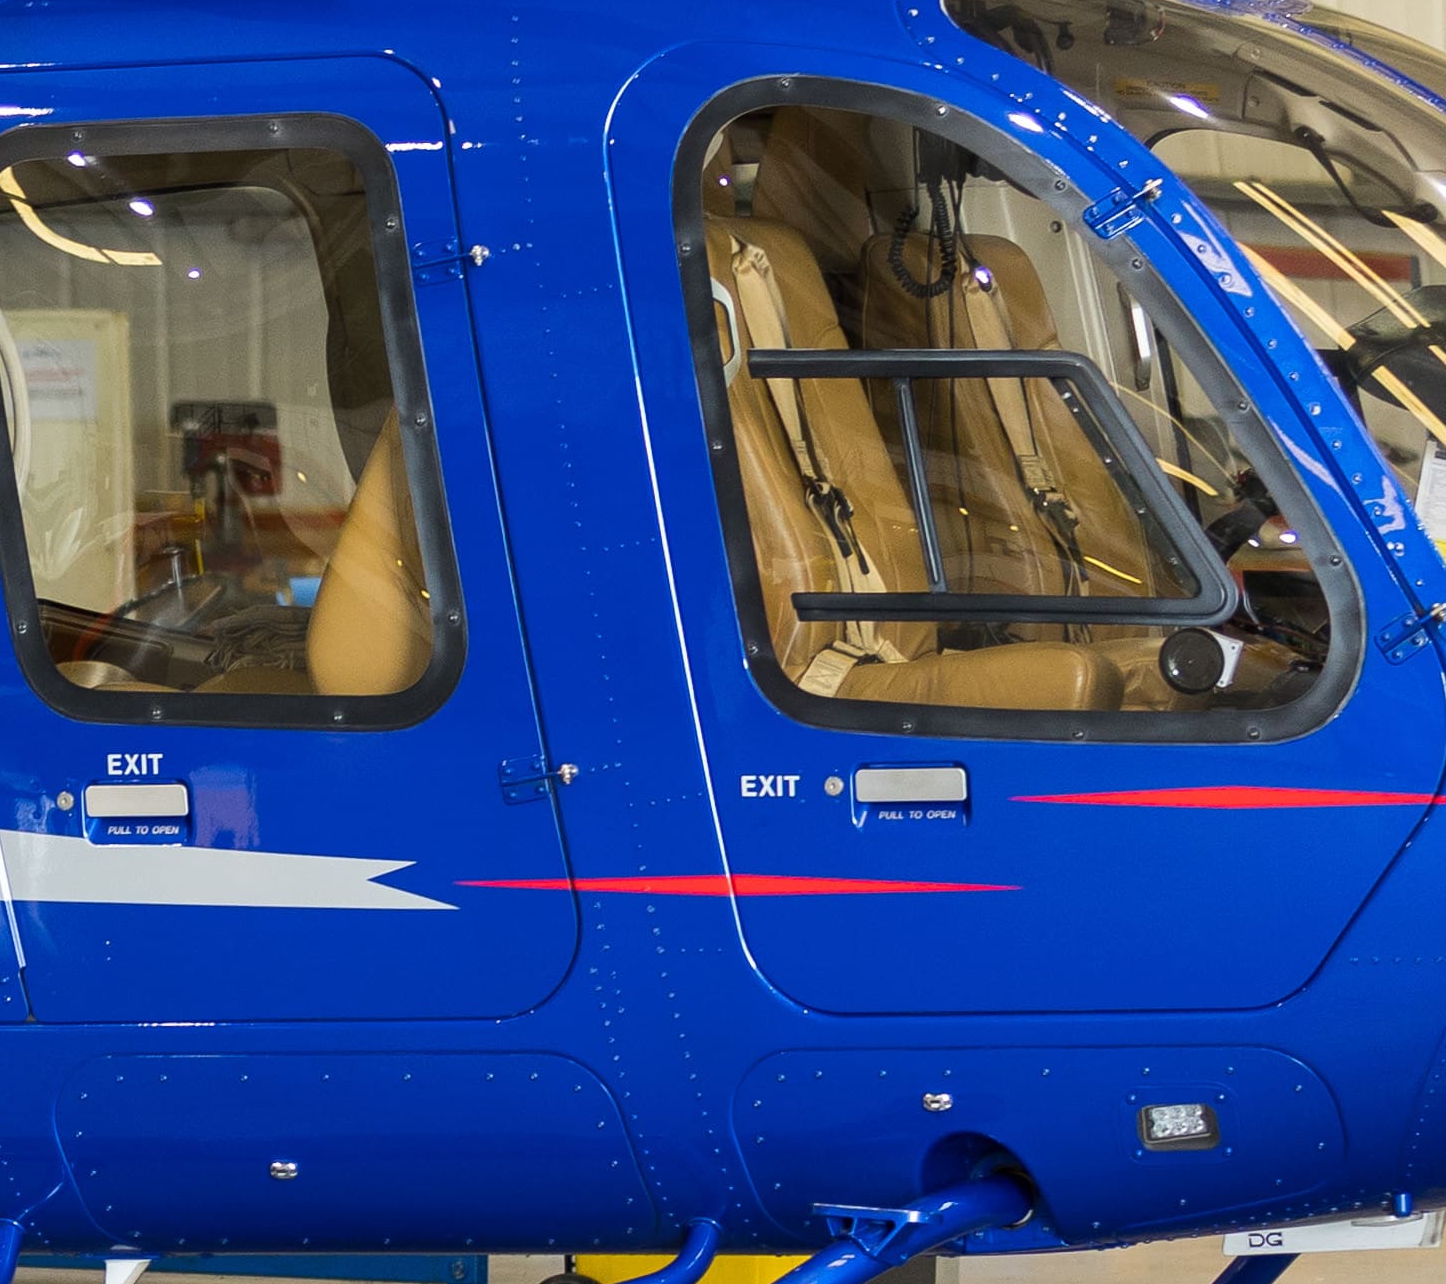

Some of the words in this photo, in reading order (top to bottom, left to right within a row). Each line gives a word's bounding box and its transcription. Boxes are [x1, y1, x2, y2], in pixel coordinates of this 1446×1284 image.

[106, 753, 164, 776] EXIT
[740, 774, 801, 798] EXIT
[878, 810, 904, 820] PULL
[908, 810, 924, 819] TO
[926, 810, 957, 819] OPEN
[107, 825, 132, 835] PULL
[135, 825, 150, 835] TO
[151, 825, 180, 835] OPEN
[1247, 1232, 1283, 1248] DG
